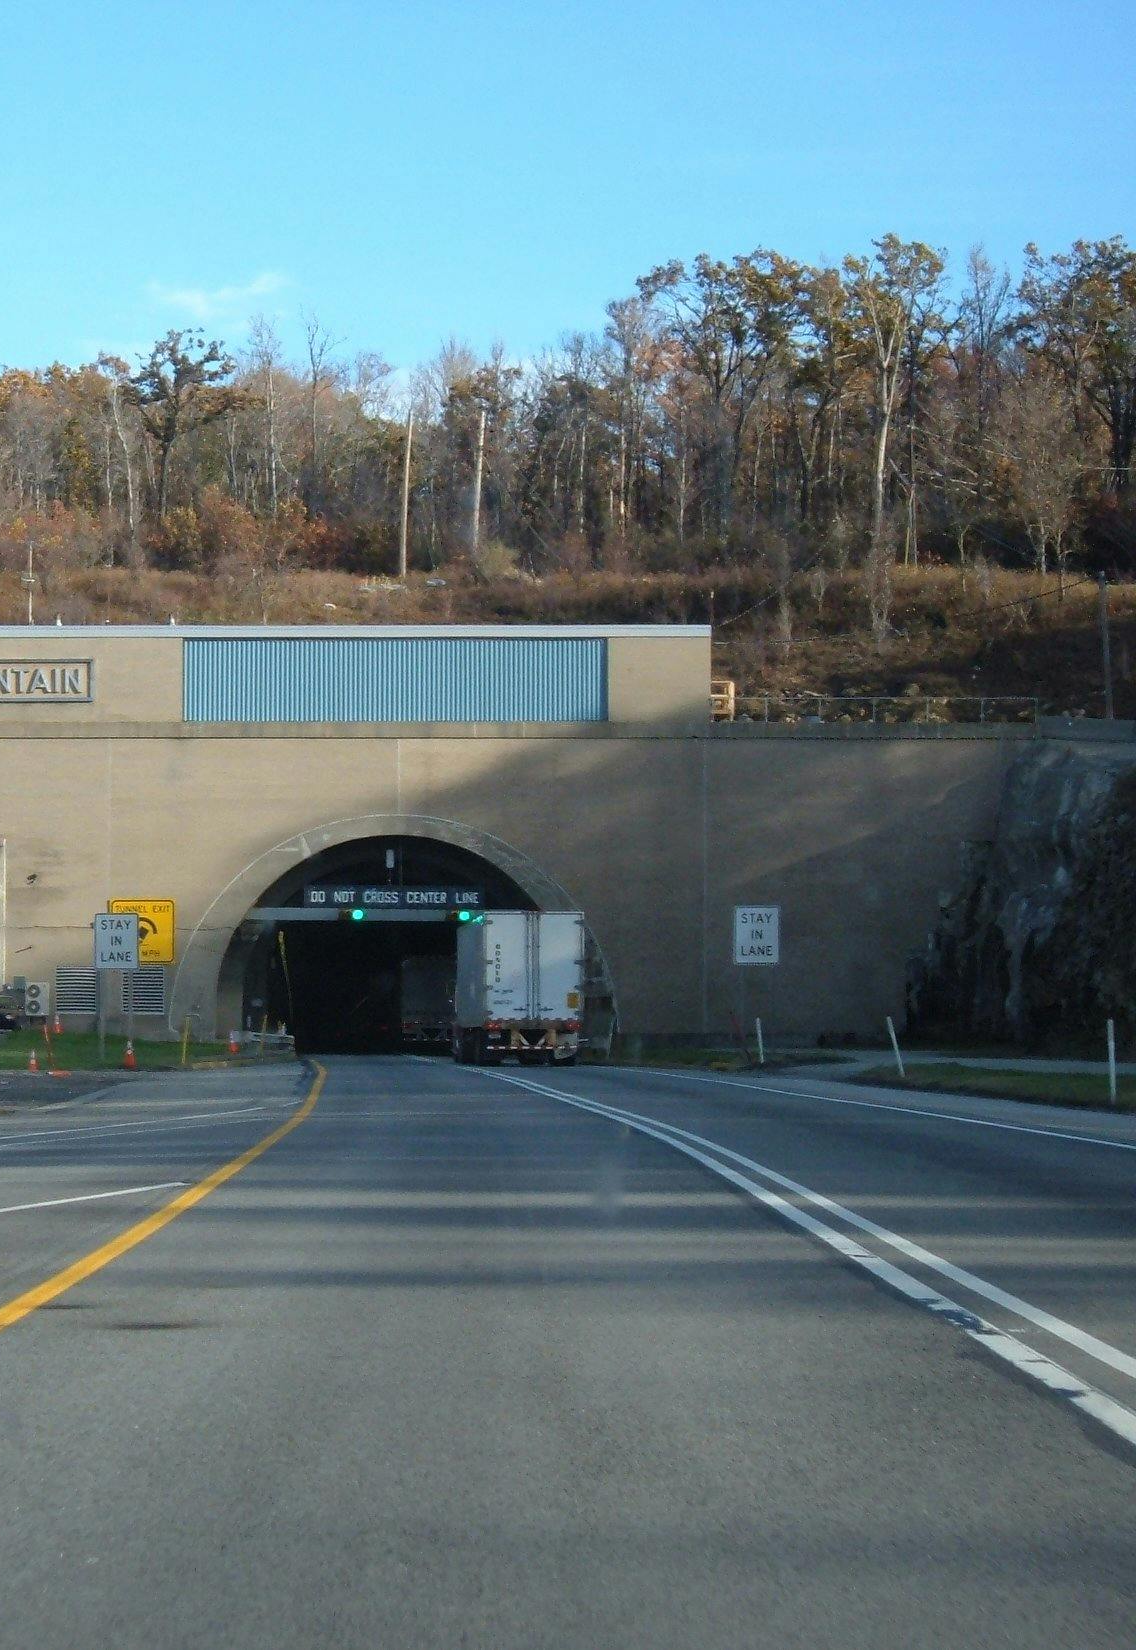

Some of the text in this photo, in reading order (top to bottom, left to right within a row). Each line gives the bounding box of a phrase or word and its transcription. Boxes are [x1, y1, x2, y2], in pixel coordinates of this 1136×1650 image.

[310, 891, 480, 904] DO NOT CROSS CENTER LINE
[741, 913, 773, 924] STAY
[100, 919, 131, 930] STAY
[751, 930, 763, 939] IN
[110, 936, 122, 946] IN
[740, 945, 773, 956] LANE
[100, 951, 132, 962] LANE
